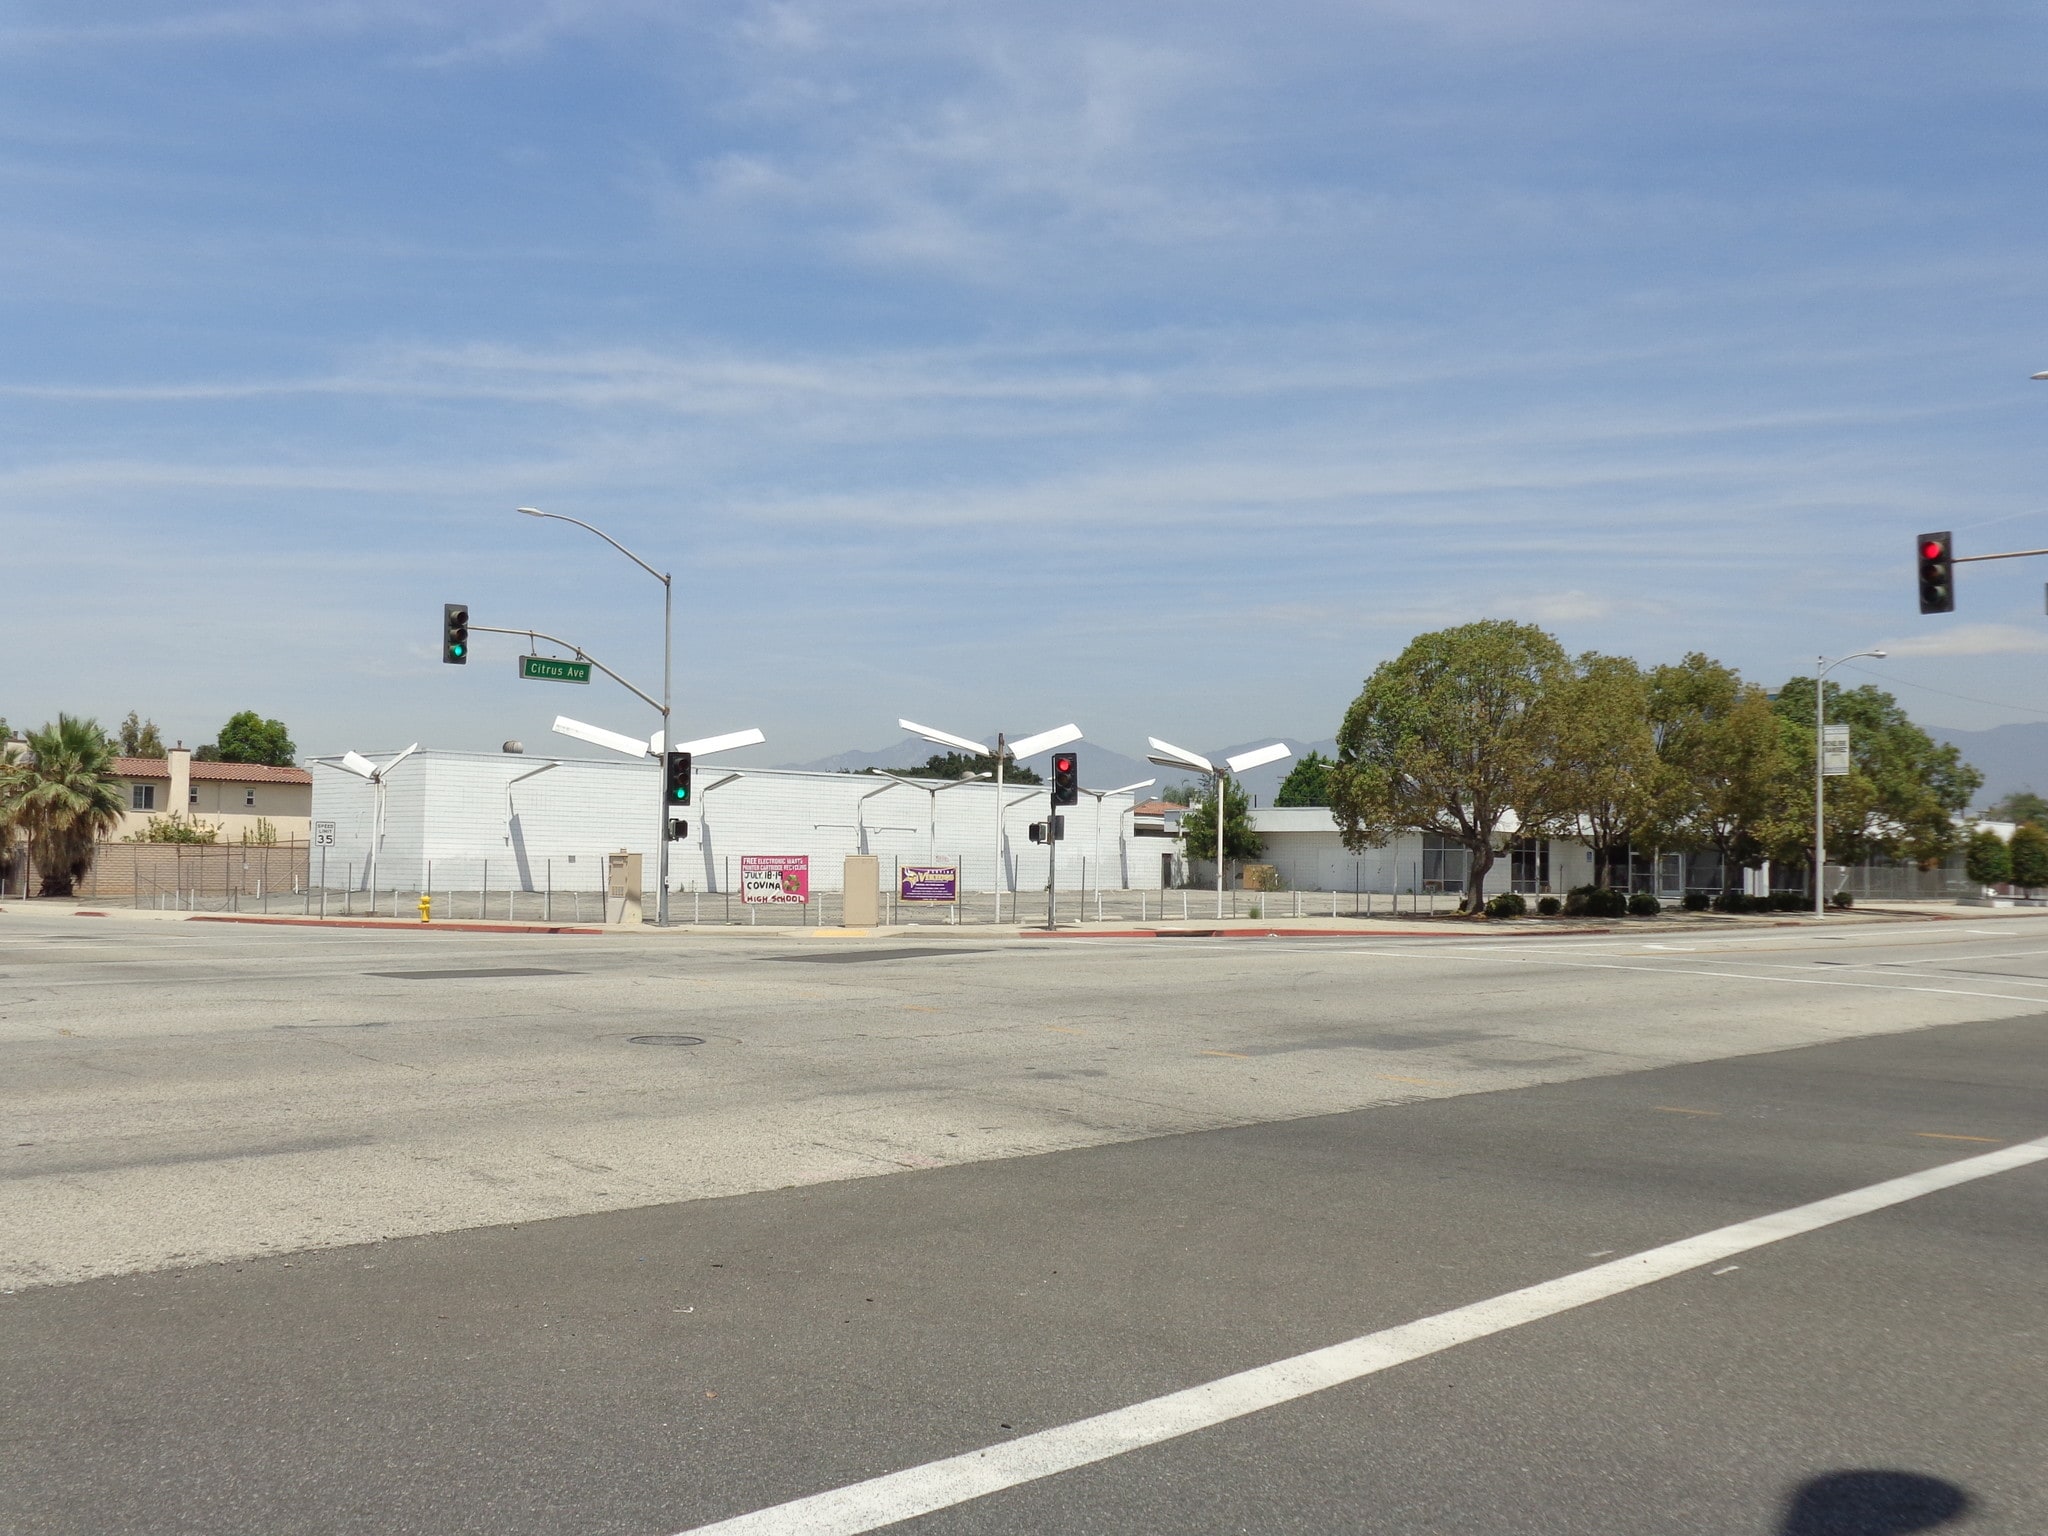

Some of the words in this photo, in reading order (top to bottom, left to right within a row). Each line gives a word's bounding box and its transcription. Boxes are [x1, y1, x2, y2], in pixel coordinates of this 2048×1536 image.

[531, 663, 563, 676] Citrus
[567, 667, 584, 678] Ave
[317, 834, 333, 844] 35
[747, 881, 781, 890] COVINA
